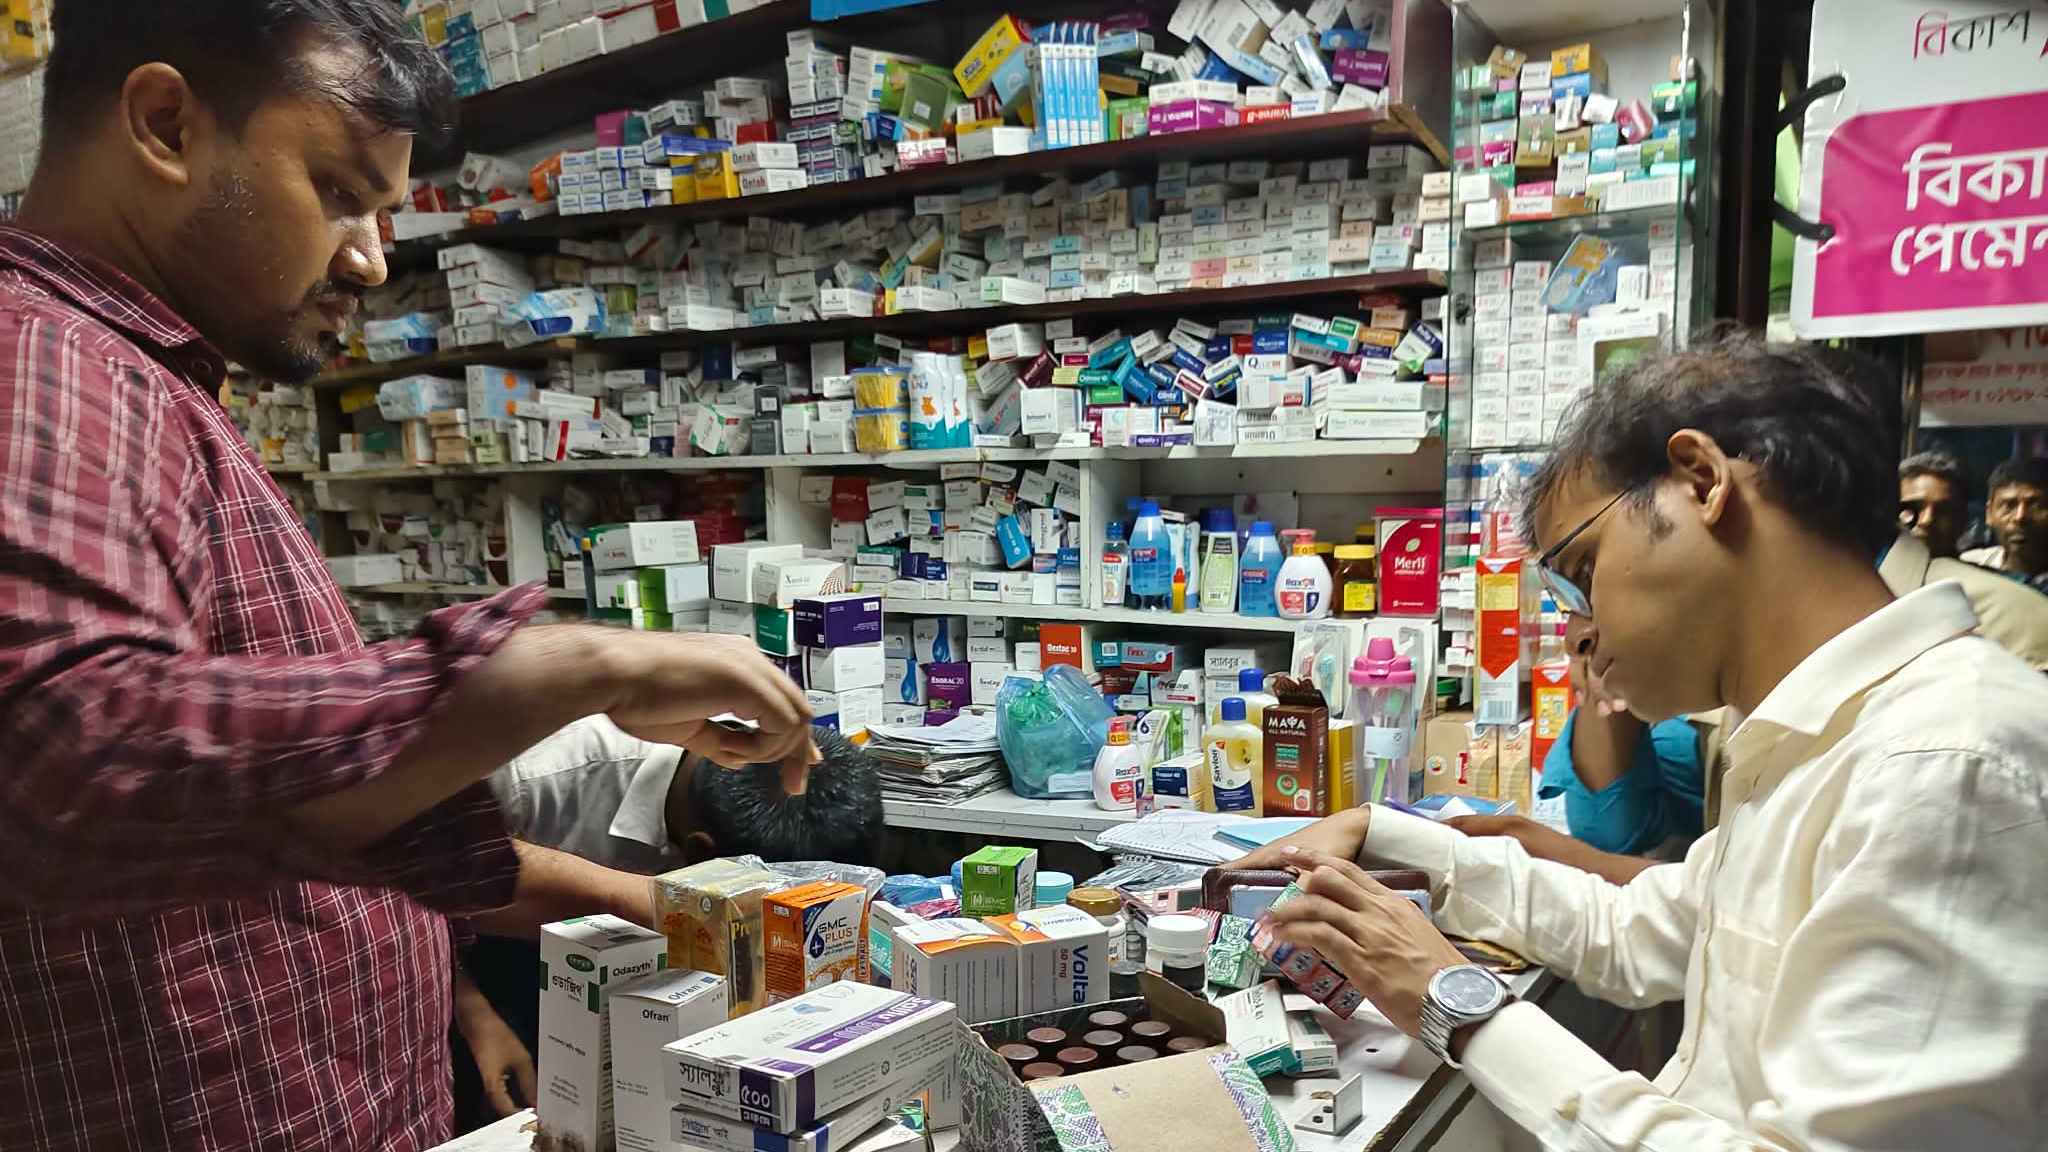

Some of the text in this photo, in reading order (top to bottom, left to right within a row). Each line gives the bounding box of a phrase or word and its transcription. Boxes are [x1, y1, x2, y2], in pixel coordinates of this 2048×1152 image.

[1902, 142, 2048, 212] বিকা
[1211, 749, 1222, 783] Savlon
[818, 917, 848, 934] SMC
[825, 927, 853, 943] PLUS
[613, 961, 652, 977] Odazyth
[1059, 962, 1068, 978] mg
[1073, 944, 1089, 1006] Volta
[668, 984, 702, 1001] Ofran
[642, 1008, 670, 1022] Ofran
[741, 1085, 770, 1109] ৫০০
